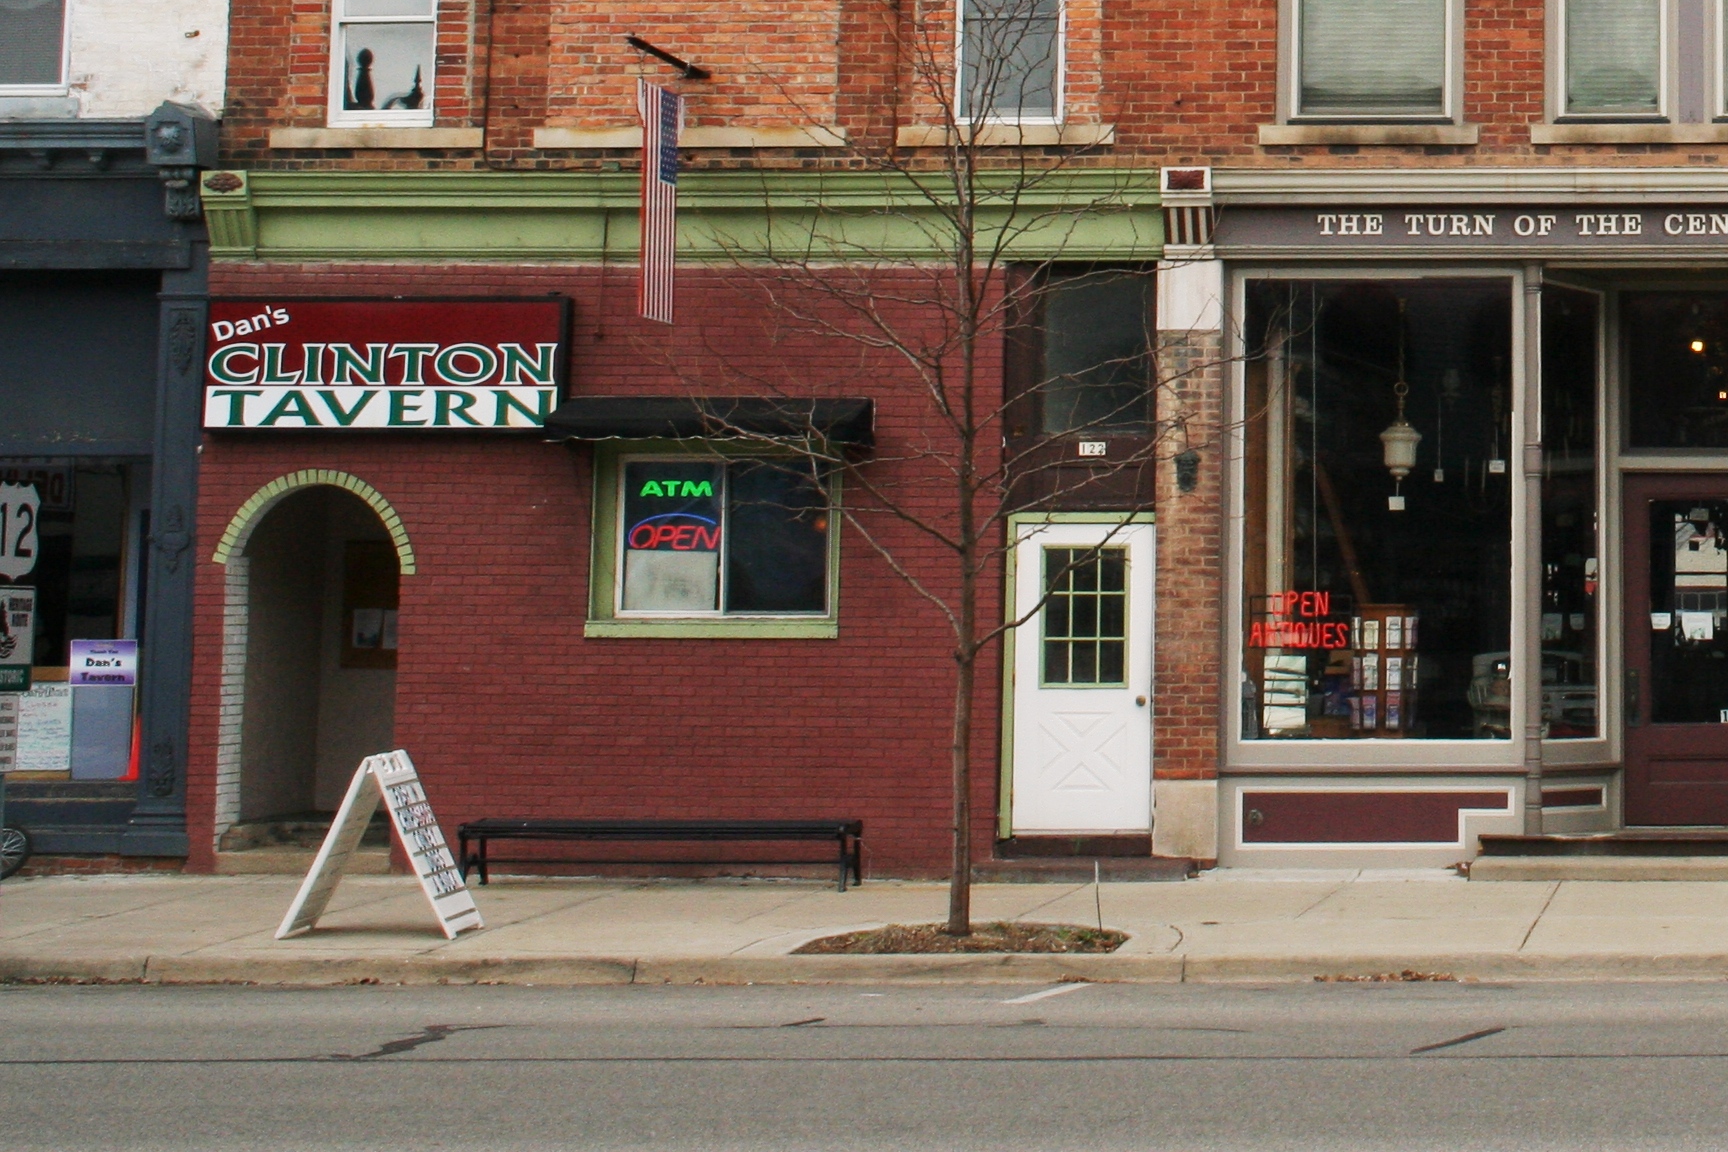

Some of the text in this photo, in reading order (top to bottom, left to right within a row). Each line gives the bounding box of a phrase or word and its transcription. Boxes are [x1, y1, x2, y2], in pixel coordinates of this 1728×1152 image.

[1317, 214, 1383, 236] THE
[1405, 214, 1496, 236] TURN
[1513, 214, 1556, 236] OF
[1576, 214, 1642, 236] THE
[211, 305, 291, 342] Dan's
[208, 342, 559, 386] CLINTON
[212, 389, 556, 427] TAVERN
[1082, 443, 1105, 455] 122
[640, 480, 713, 497] ATM
[1, 502, 33, 558] 12
[630, 524, 722, 550] OPEN
[1271, 590, 1330, 618] OPEN
[1249, 621, 1349, 648] ANTIQUES
[86, 657, 121, 667] Dan's
[80, 672, 125, 682] Tavern
